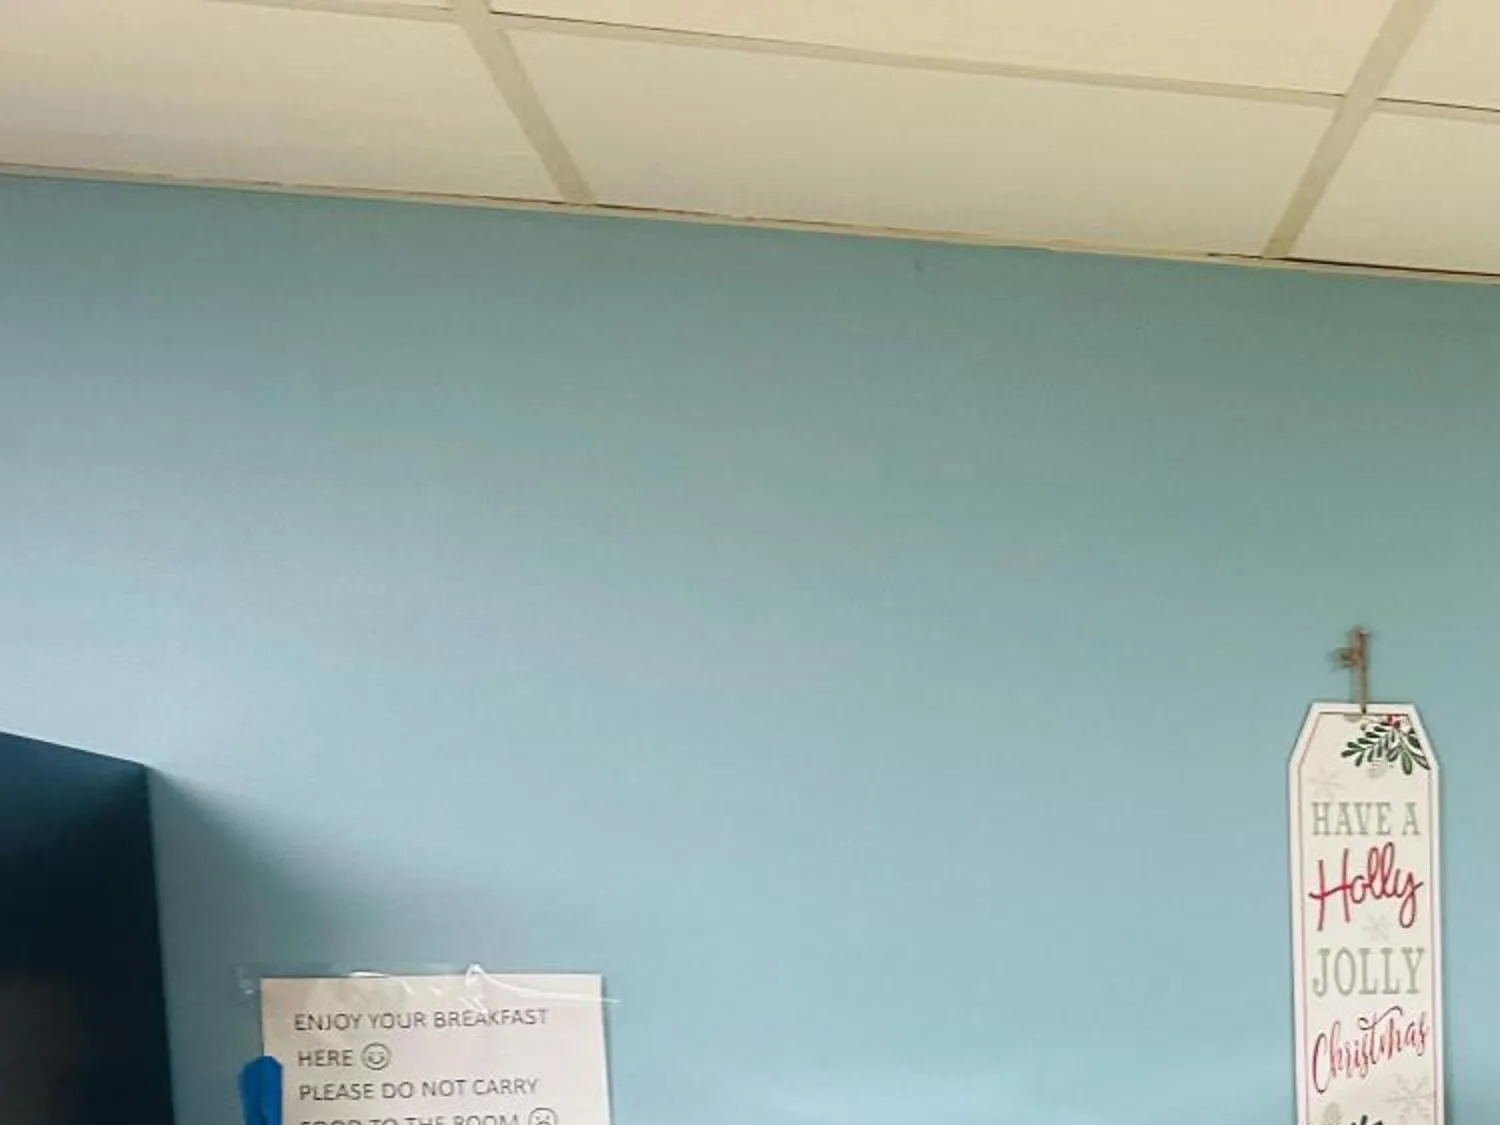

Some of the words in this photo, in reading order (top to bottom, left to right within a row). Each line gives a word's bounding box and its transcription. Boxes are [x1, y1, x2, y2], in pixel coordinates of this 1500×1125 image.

[1312, 802, 1391, 836] HAVE
[1402, 802, 1421, 835] A
[1308, 841, 1424, 932] Holly
[1312, 947, 1425, 997] JOLLY
[294, 1013, 362, 1032] ENJOY
[367, 1010, 427, 1030] YOUR
[433, 1008, 549, 1027] BREAKFAST
[298, 1050, 353, 1067] HERE
[1312, 1005, 1430, 1094] Christmas
[299, 1082, 375, 1102] PLEASE
[381, 1081, 414, 1099] DO
[421, 1079, 466, 1098] NOT
[472, 1078, 541, 1096] CARRY
